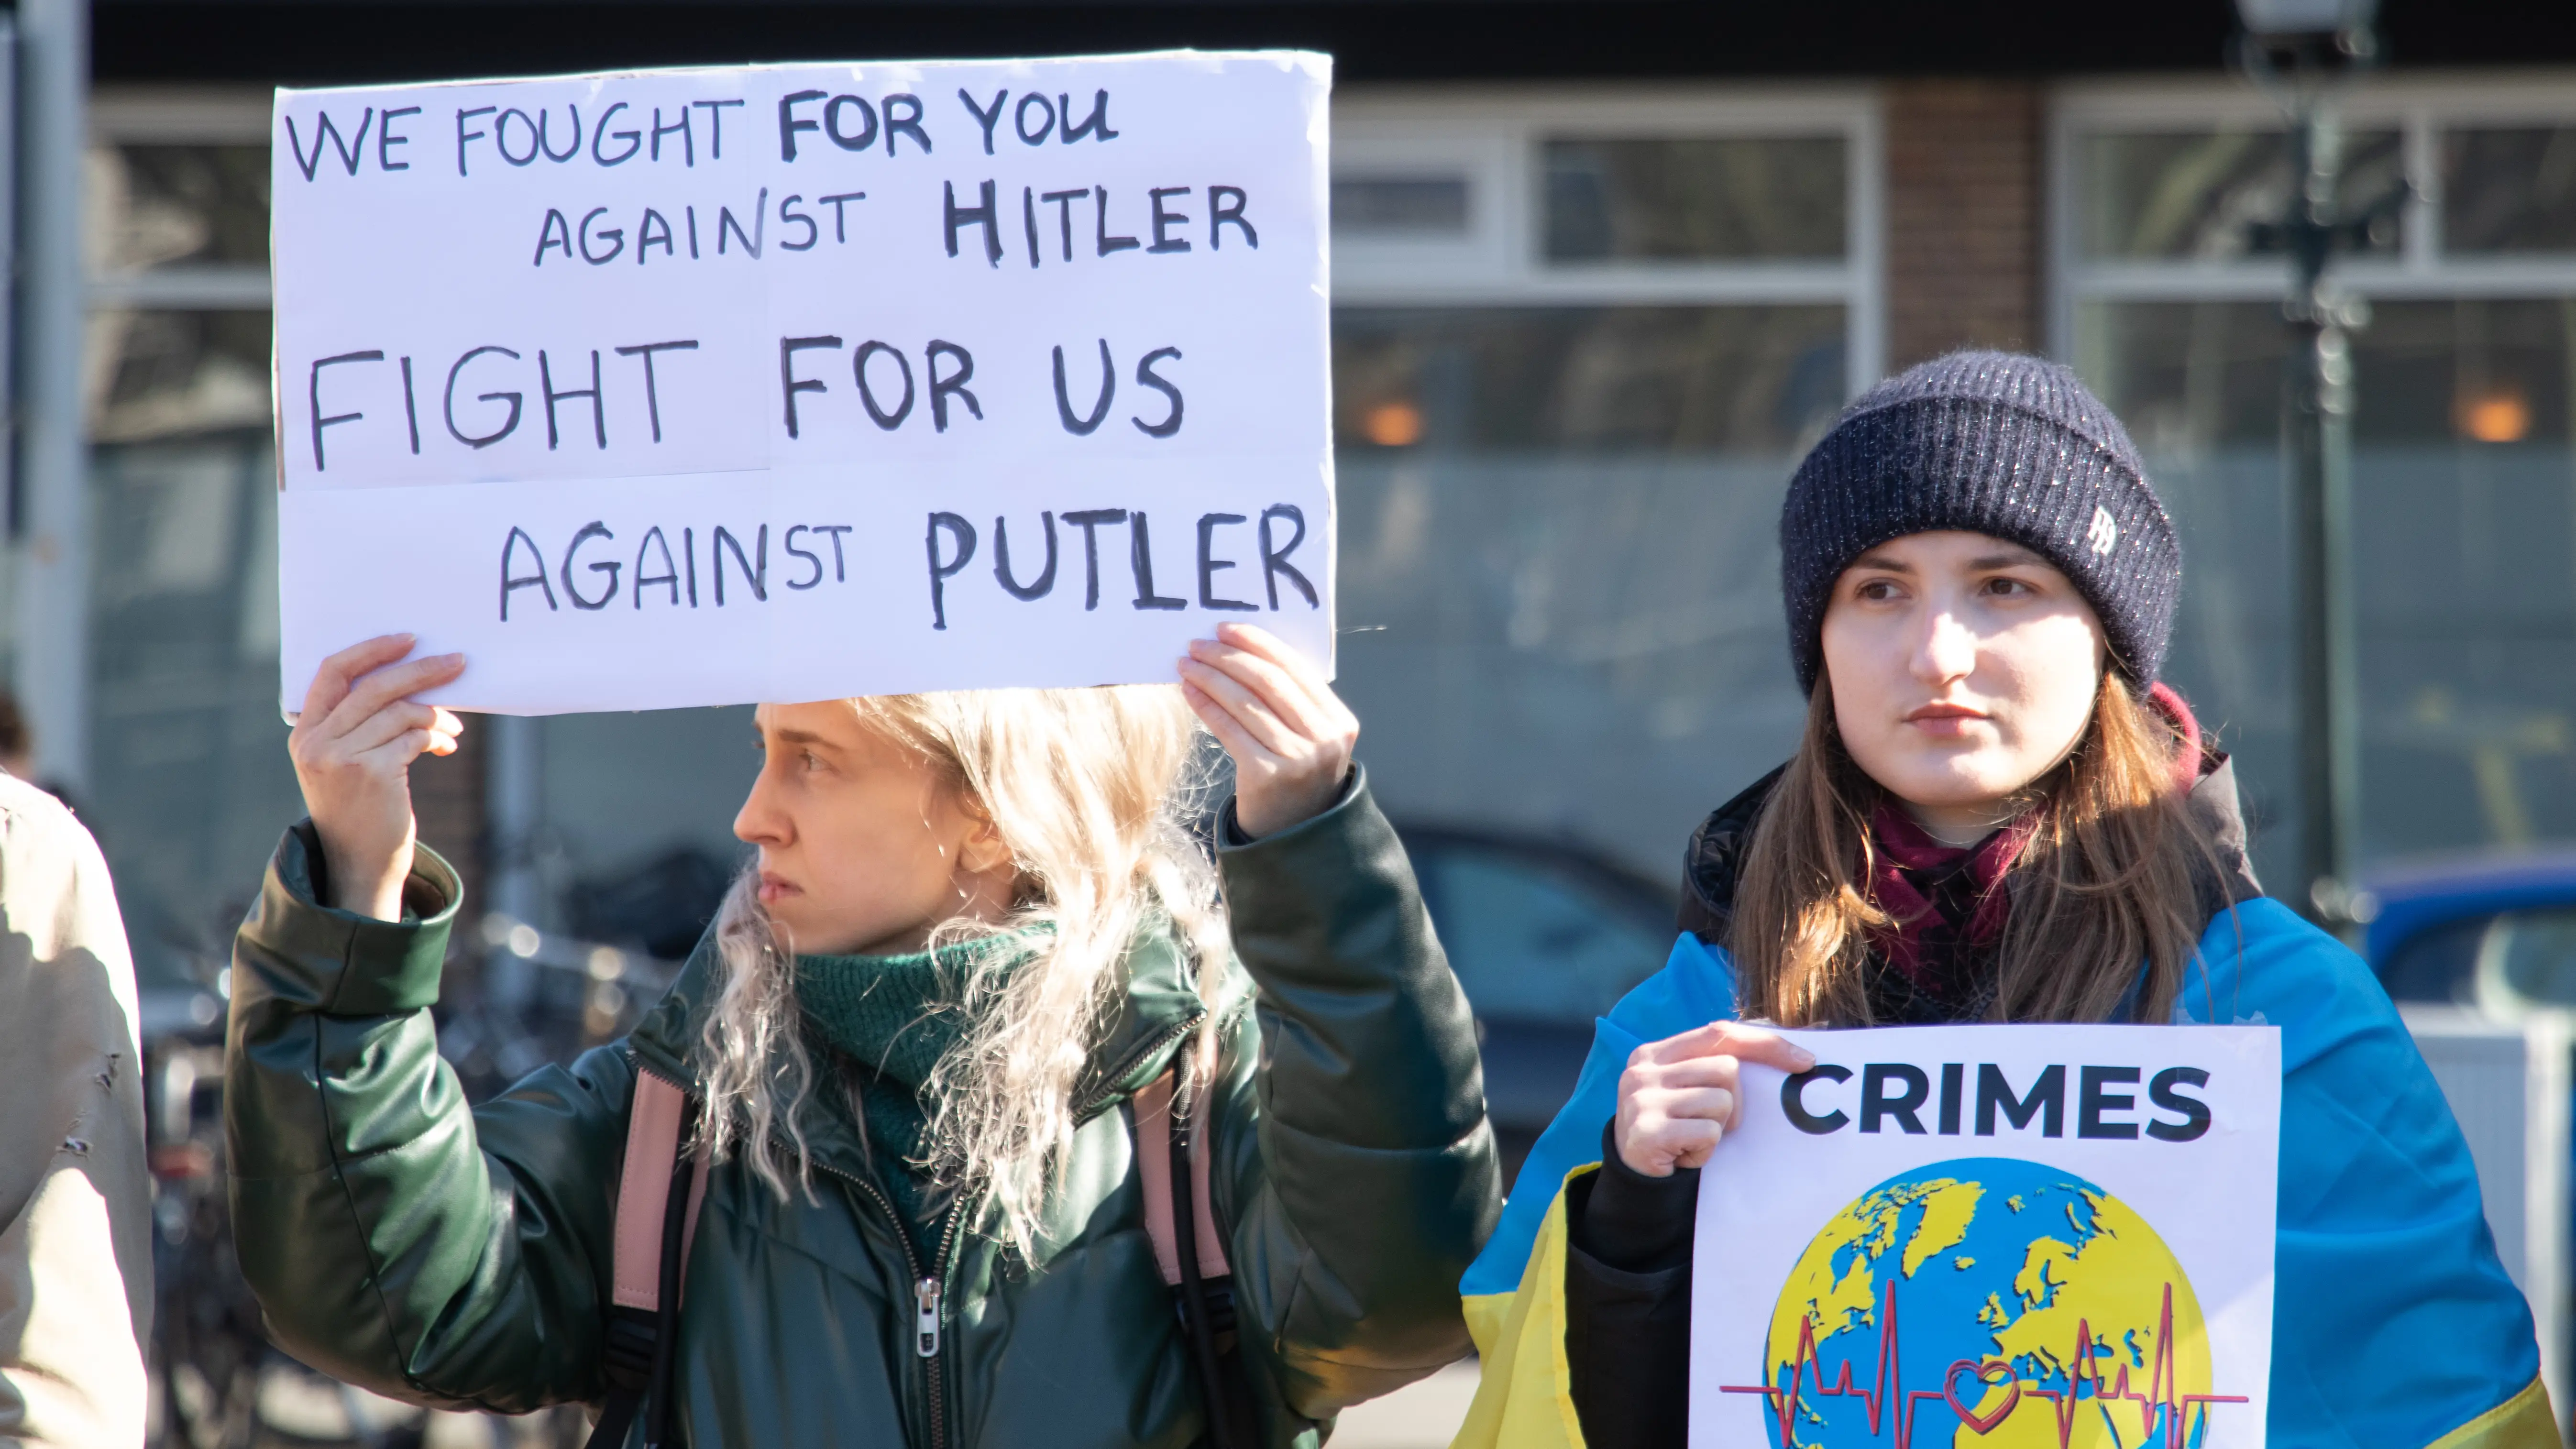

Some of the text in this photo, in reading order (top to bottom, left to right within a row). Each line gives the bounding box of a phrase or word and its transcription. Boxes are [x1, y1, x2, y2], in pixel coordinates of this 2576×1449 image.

[285, 106, 421, 182] WE
[456, 99, 744, 176] FOUGHT
[779, 90, 932, 163] FOR
[534, 179, 1258, 268] AGAINST HITLER
[310, 335, 1184, 472] FIGHT FOR US
[500, 504, 1319, 630] AGAINST PUTLER
[1781, 1064, 2211, 1142] CRIMES
